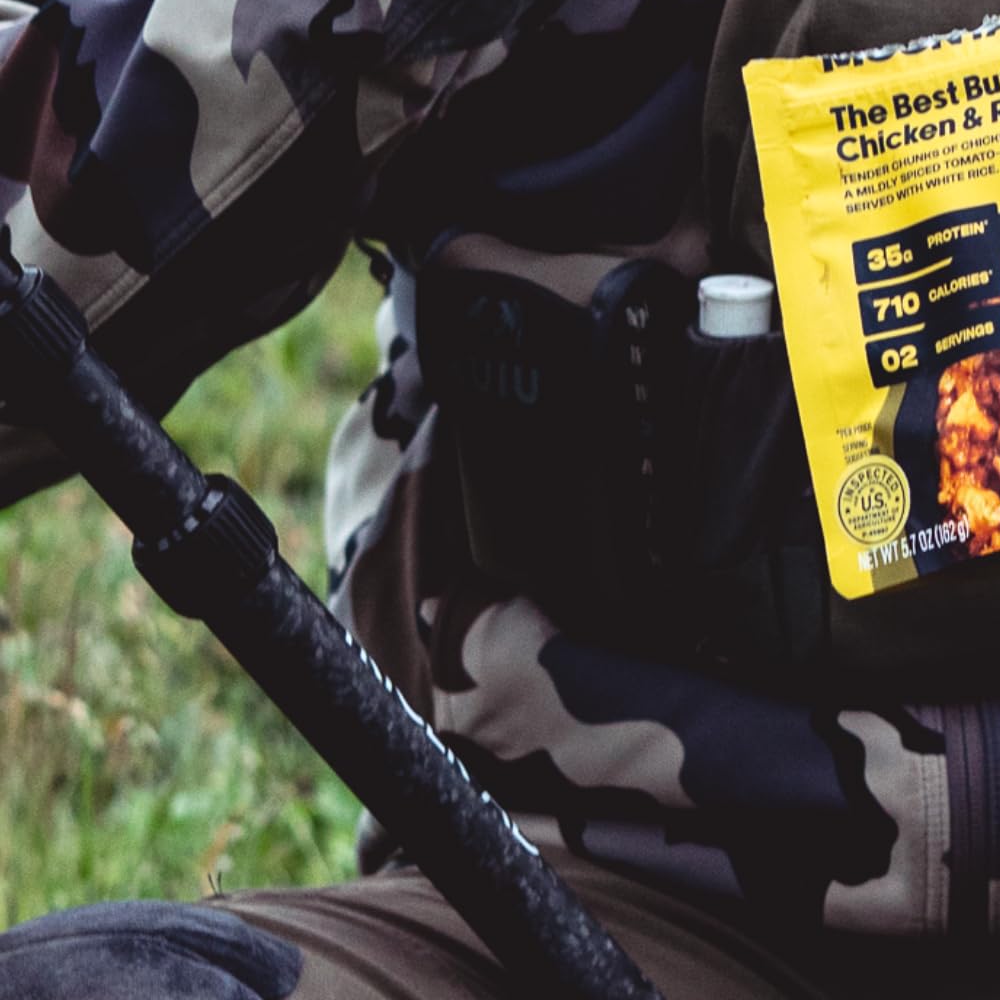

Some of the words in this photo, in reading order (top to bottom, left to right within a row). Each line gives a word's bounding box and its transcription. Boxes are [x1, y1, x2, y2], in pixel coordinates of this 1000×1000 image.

[829, 103, 888, 132] The
[892, 81, 960, 120] Best
[836, 118, 956, 162] Chicken
[963, 106, 982, 131] &
[842, 163, 889, 184] TENDER
[891, 149, 940, 171] CHUNKS
[942, 144, 958, 156] OF
[844, 190, 853, 199] A
[856, 177, 898, 197] MILDLY
[900, 163, 941, 184] SPICED
[845, 195, 895, 214] SERVED
[896, 183, 924, 201] WITH
[925, 171, 965, 190] WHITE
[967, 164, 999, 180] RICE.
[873, 291, 921, 322] 710
[880, 344, 918, 373] 02
[935, 321, 994, 354] SERVINGS
[843, 467, 900, 502] INSPECTED
[861, 492, 888, 513] U.S.
[857, 548, 879, 572] NET
[880, 540, 899, 565] WT
[901, 532, 917, 559] 5.7
[919, 527, 935, 552] OZ
[934, 519, 957, 549] (162
[957, 514, 970, 543] g)
